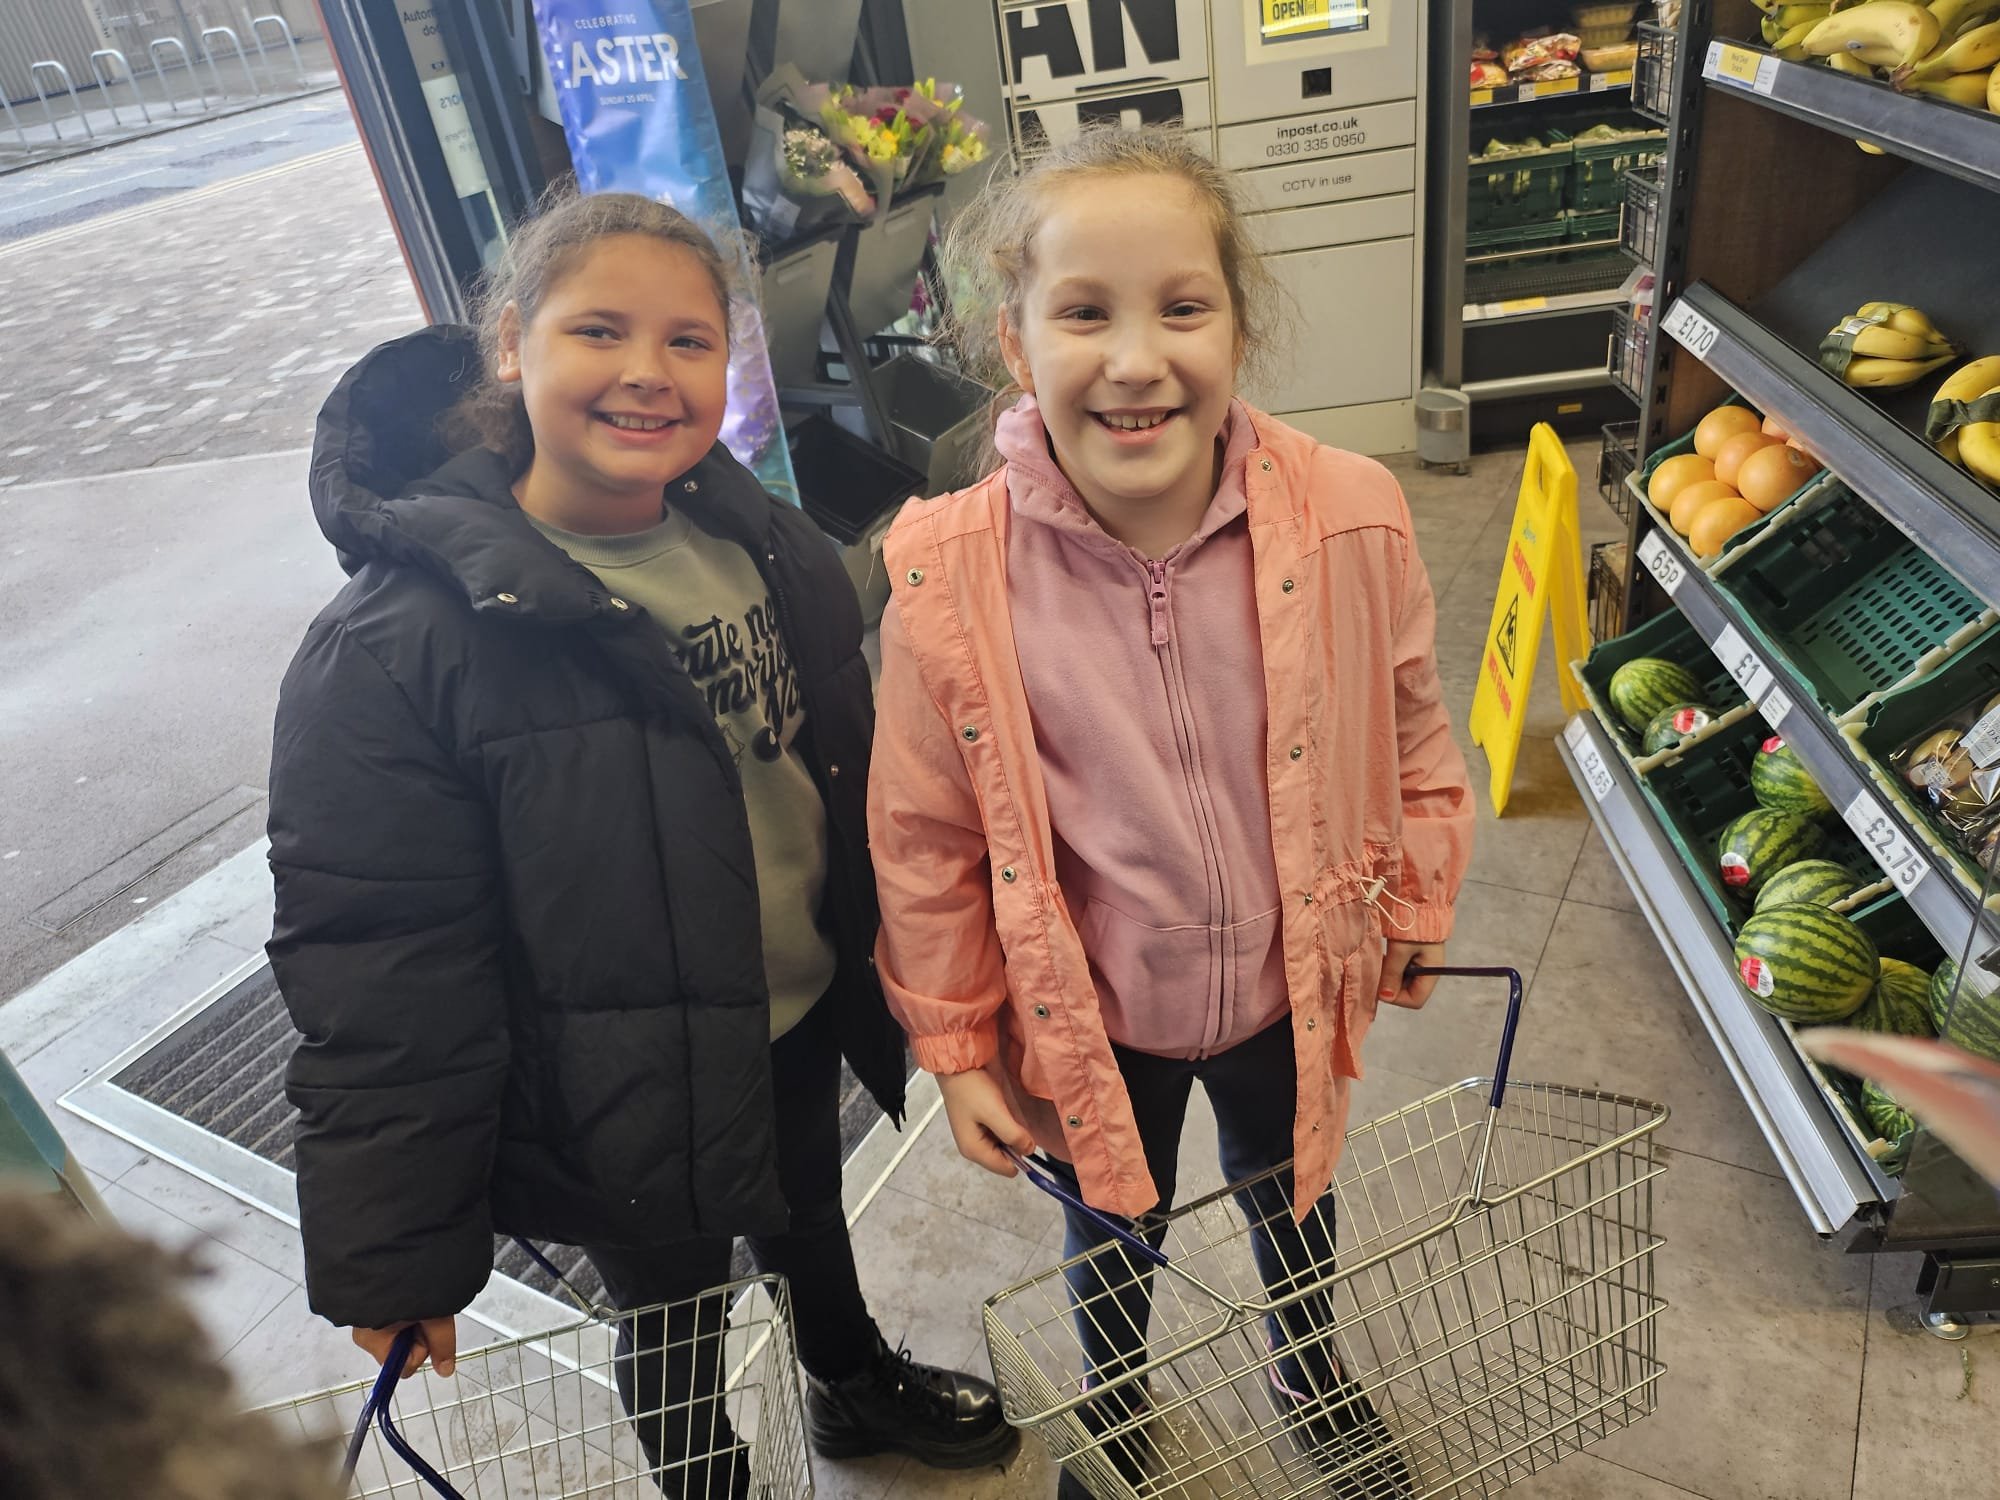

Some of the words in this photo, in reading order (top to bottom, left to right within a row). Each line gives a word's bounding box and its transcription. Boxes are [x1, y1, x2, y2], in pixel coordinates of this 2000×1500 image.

[575, 14, 637, 29] CELEBRATING
[1266, 141, 1299, 158] 0330
[1304, 137, 1329, 152] 335
[1332, 132, 1366, 148] 0950
[1277, 117, 1358, 140] inpost.co.uk
[1282, 178, 1316, 192] CCTV
[1320, 177, 1329, 187] in
[1332, 174, 1352, 185] use
[1678, 314, 1714, 352] £1.70
[1652, 550, 1679, 586] 65p
[1734, 653, 1761, 687] £1
[1584, 751, 1611, 794] £2.65
[1865, 817, 1924, 885] £2.75
